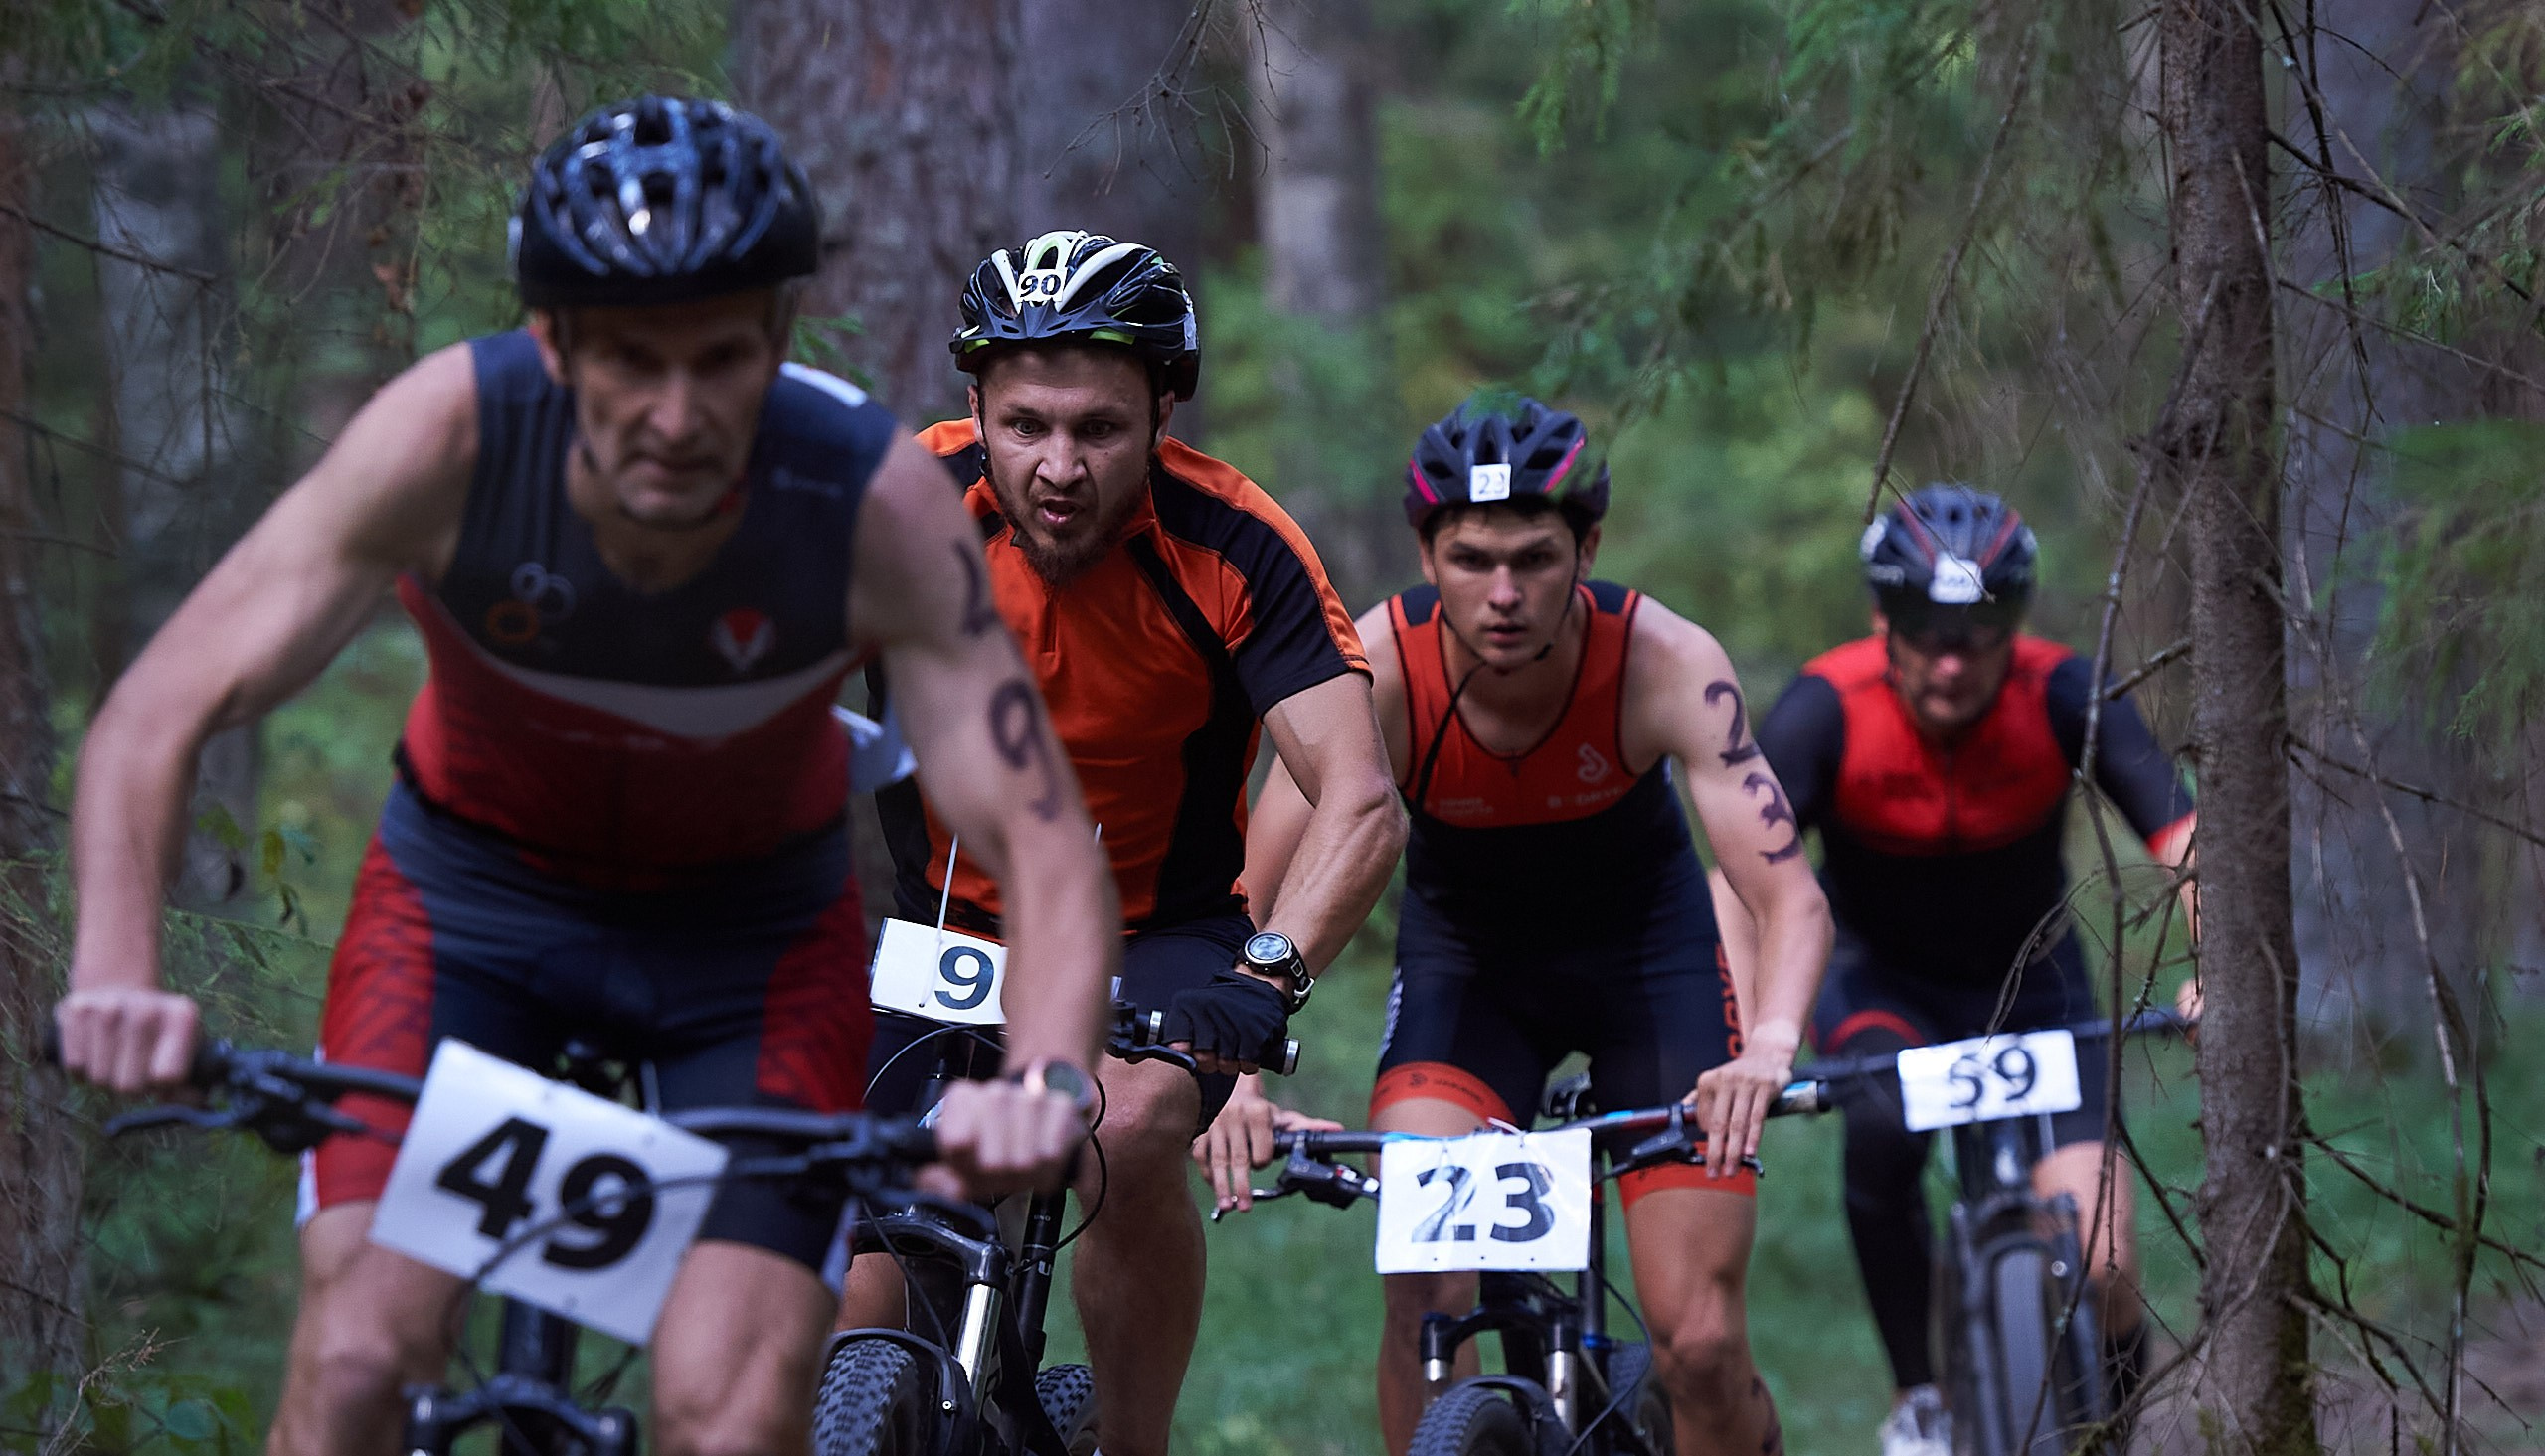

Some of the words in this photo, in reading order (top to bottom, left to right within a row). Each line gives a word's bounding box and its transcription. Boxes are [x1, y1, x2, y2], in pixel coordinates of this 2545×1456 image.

[1020, 274, 1062, 298] 90
[1704, 680, 1803, 864] 23
[934, 945, 994, 1011] 9
[1949, 1047, 2035, 1109] 59
[434, 1116, 654, 1269] 49
[1411, 1162, 1556, 1243] 23
